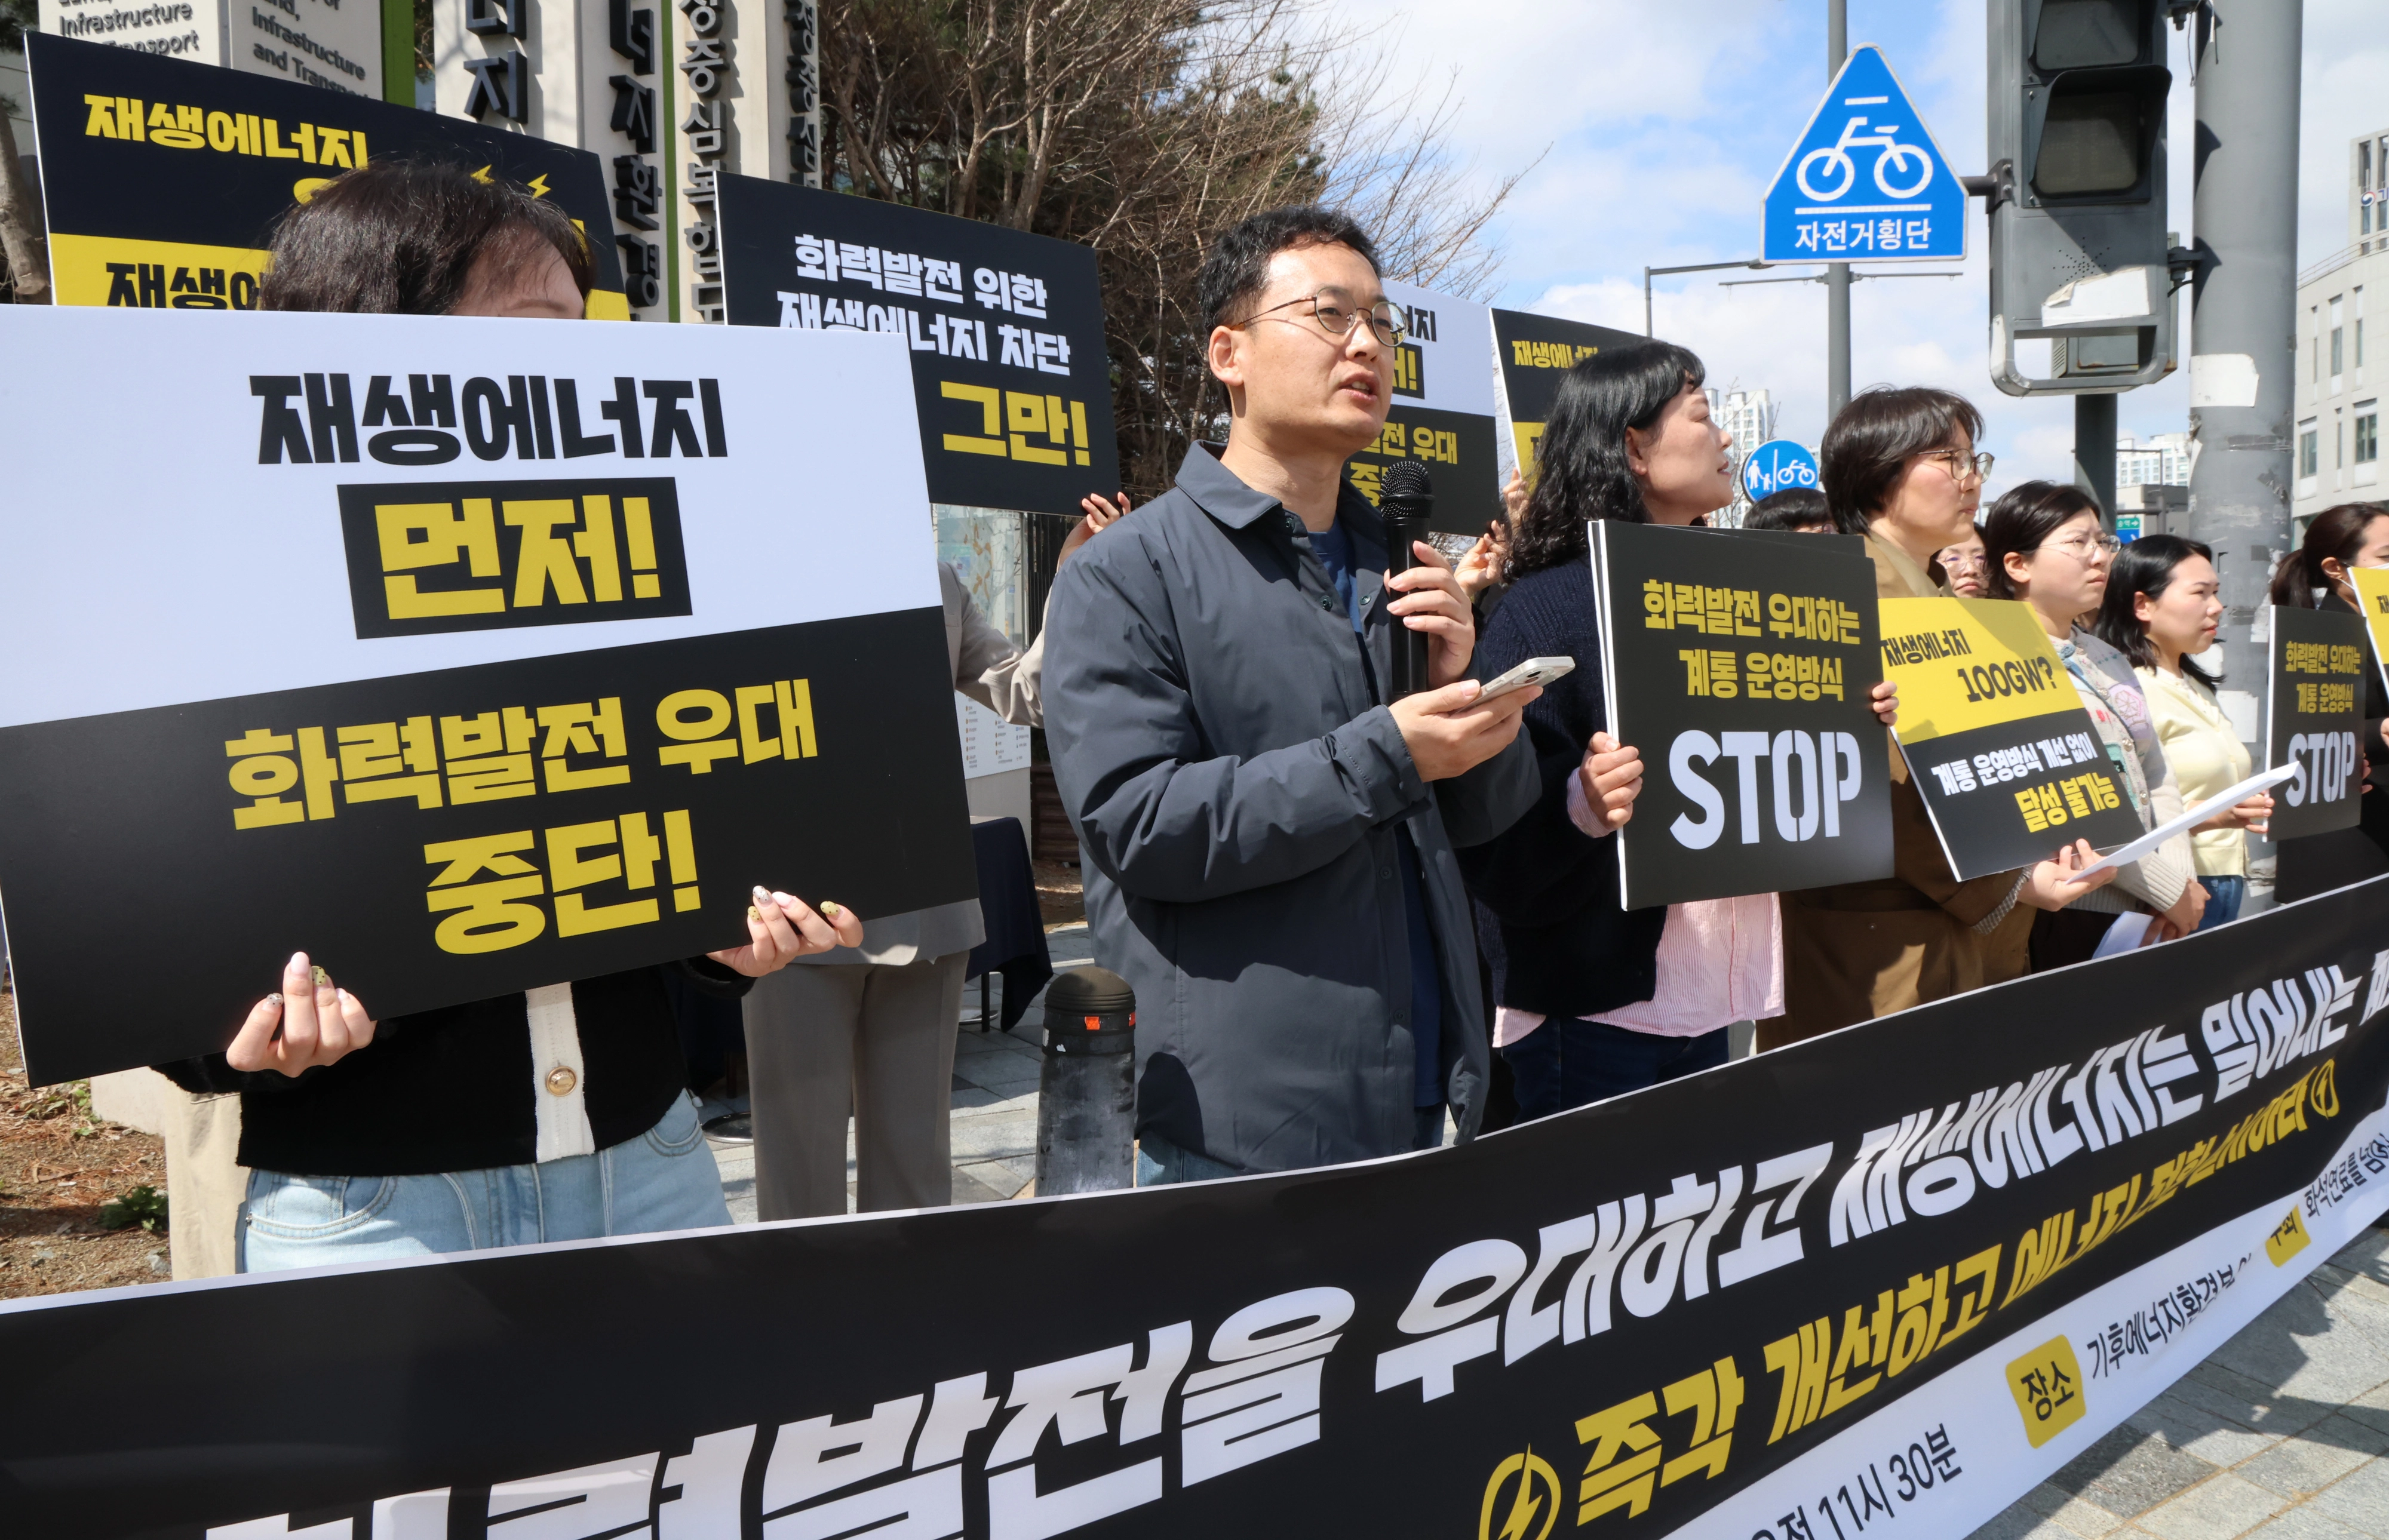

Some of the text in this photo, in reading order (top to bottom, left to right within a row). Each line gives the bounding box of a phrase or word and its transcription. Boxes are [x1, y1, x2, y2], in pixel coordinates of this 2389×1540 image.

[59, 2, 193, 37] Infrastructure
[253, 6, 366, 81] Infrastructure
[253, 43, 288, 72] and
[84, 94, 369, 170] 재생에너지
[1795, 218, 1932, 252] 자전거횡단
[795, 233, 1047, 319] 화력발전 위한
[777, 290, 1071, 376] 재생에너지 차단
[249, 373, 728, 466] 재생에너지
[941, 381, 1091, 466] 그만!
[1413, 427, 1458, 465] 우대
[374, 494, 661, 620] 먼저!
[1643, 579, 1860, 645] 화력발전 우대하는
[1881, 628, 1972, 667] 재생에너지
[1679, 649, 1844, 702] 계통 운영방식
[1957, 656, 2057, 703] 100GW?
[2286, 641, 2361, 675] 화력발전 우대하는
[2296, 683, 2354, 714] 계통 운영방식
[225, 678, 818, 830] 화력발전 우대
[1930, 731, 2098, 796] 계통 운영방식 개선 없이
[2285, 731, 2356, 807] STOP
[1669, 730, 1862, 850] STOP
[2014, 772, 2120, 833] 달성 불가능
[423, 809, 701, 954] 중단!
[1375, 1142, 1834, 1403] 우대하고
[1829, 1025, 2204, 1248] 재생에너지는
[2201, 964, 2363, 1103] 밀어내는
[2304, 1151, 2368, 1218] 화석연료를
[1574, 1355, 1745, 1526] 즉각
[1764, 1243, 2002, 1446] 개선하고
[1998, 1173, 2142, 1309] 에너지
[2020, 1360, 2074, 1422] 장소
[1818, 1463, 1895, 1540] 11시
[1889, 1423, 1963, 1502] 30분
